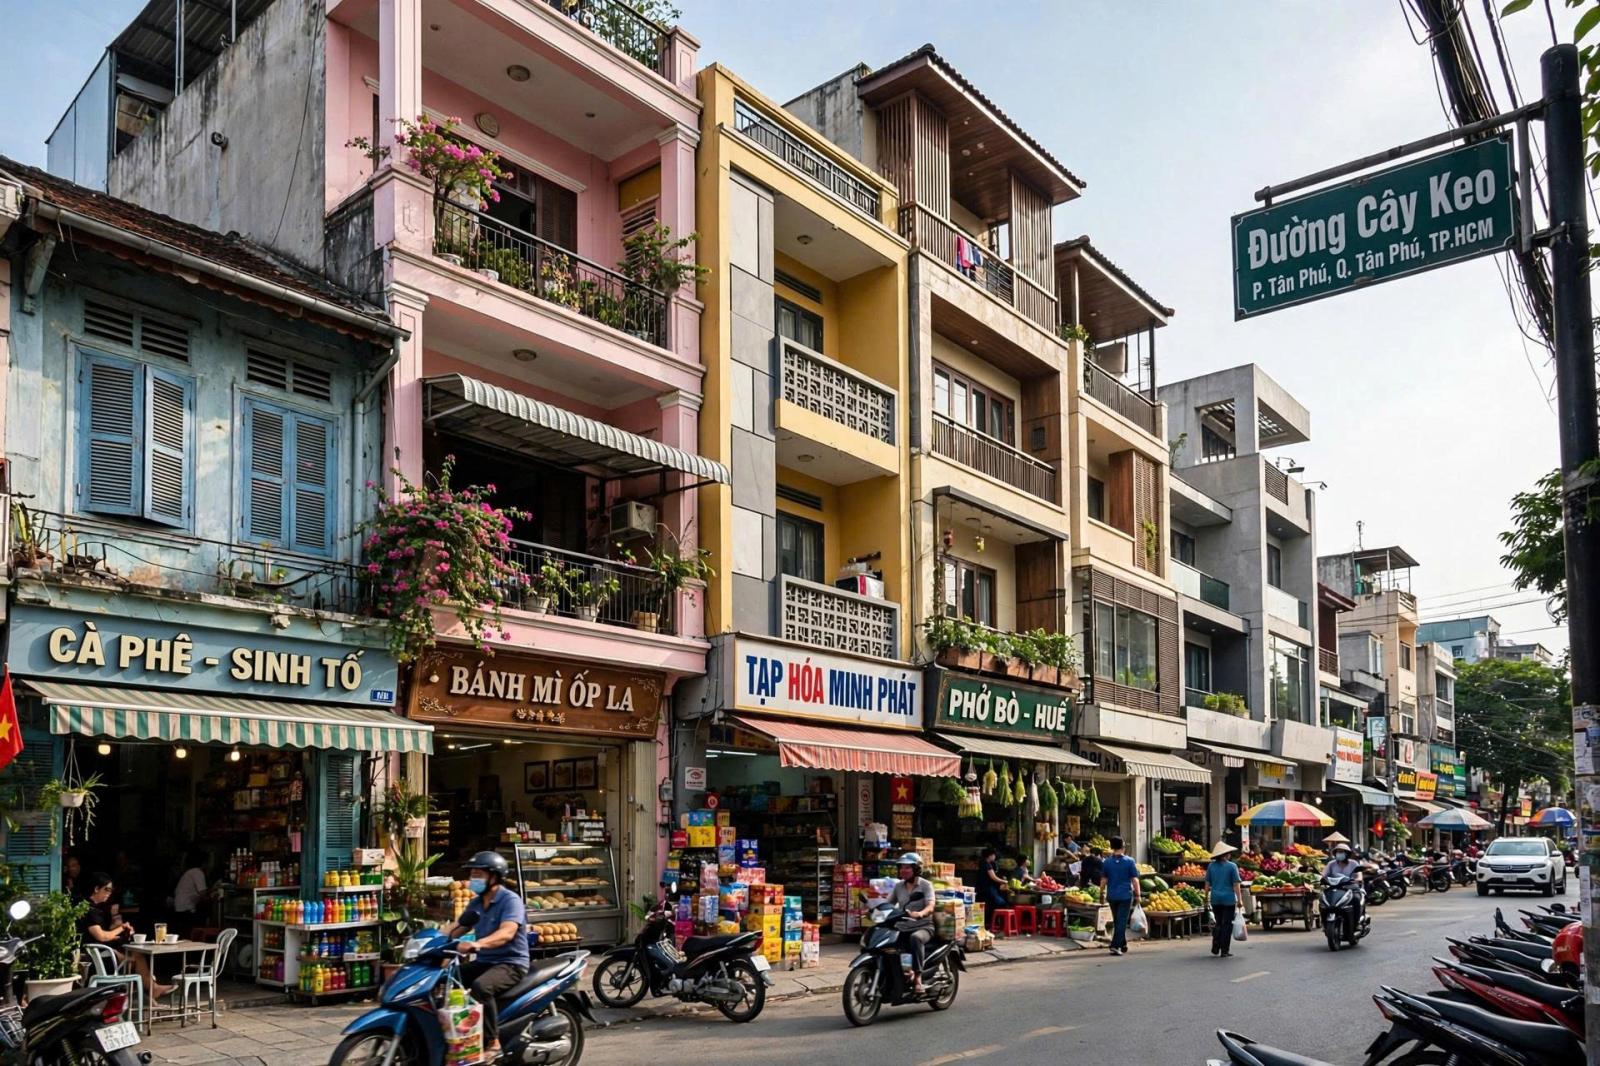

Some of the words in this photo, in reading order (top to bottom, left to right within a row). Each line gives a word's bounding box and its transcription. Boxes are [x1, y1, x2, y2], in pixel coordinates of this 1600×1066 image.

[1247, 211, 1346, 270] Đường
[1356, 188, 1419, 239] Cây
[1428, 168, 1496, 219] Keo
[1252, 281, 1265, 301] P.
[1268, 274, 1295, 297] Tân
[1299, 263, 1332, 288] Phú,
[1336, 258, 1351, 280] Q.
[1355, 250, 1385, 273] Tân
[1389, 238, 1426, 265] Phú,
[1428, 217, 1494, 254] TP.HCM
[48, 621, 106, 666] CÀ
[119, 633, 193, 674] PHÊ
[205, 657, 220, 666] -
[230, 647, 312, 686] SINH
[321, 650, 365, 691] TỐ
[449, 660, 527, 701] BÁNH
[531, 670, 564, 705] MÌ
[569, 669, 601, 708] ỐP
[605, 684, 635, 712] LA
[746, 655, 784, 705] TẠP
[788, 657, 825, 704] HÓA
[829, 669, 873, 711] MINH
[877, 673, 917, 716] PHÁT
[948, 683, 992, 721] PHỞ
[994, 691, 1020, 725] BÒ
[1034, 697, 1070, 731] HUẾ
